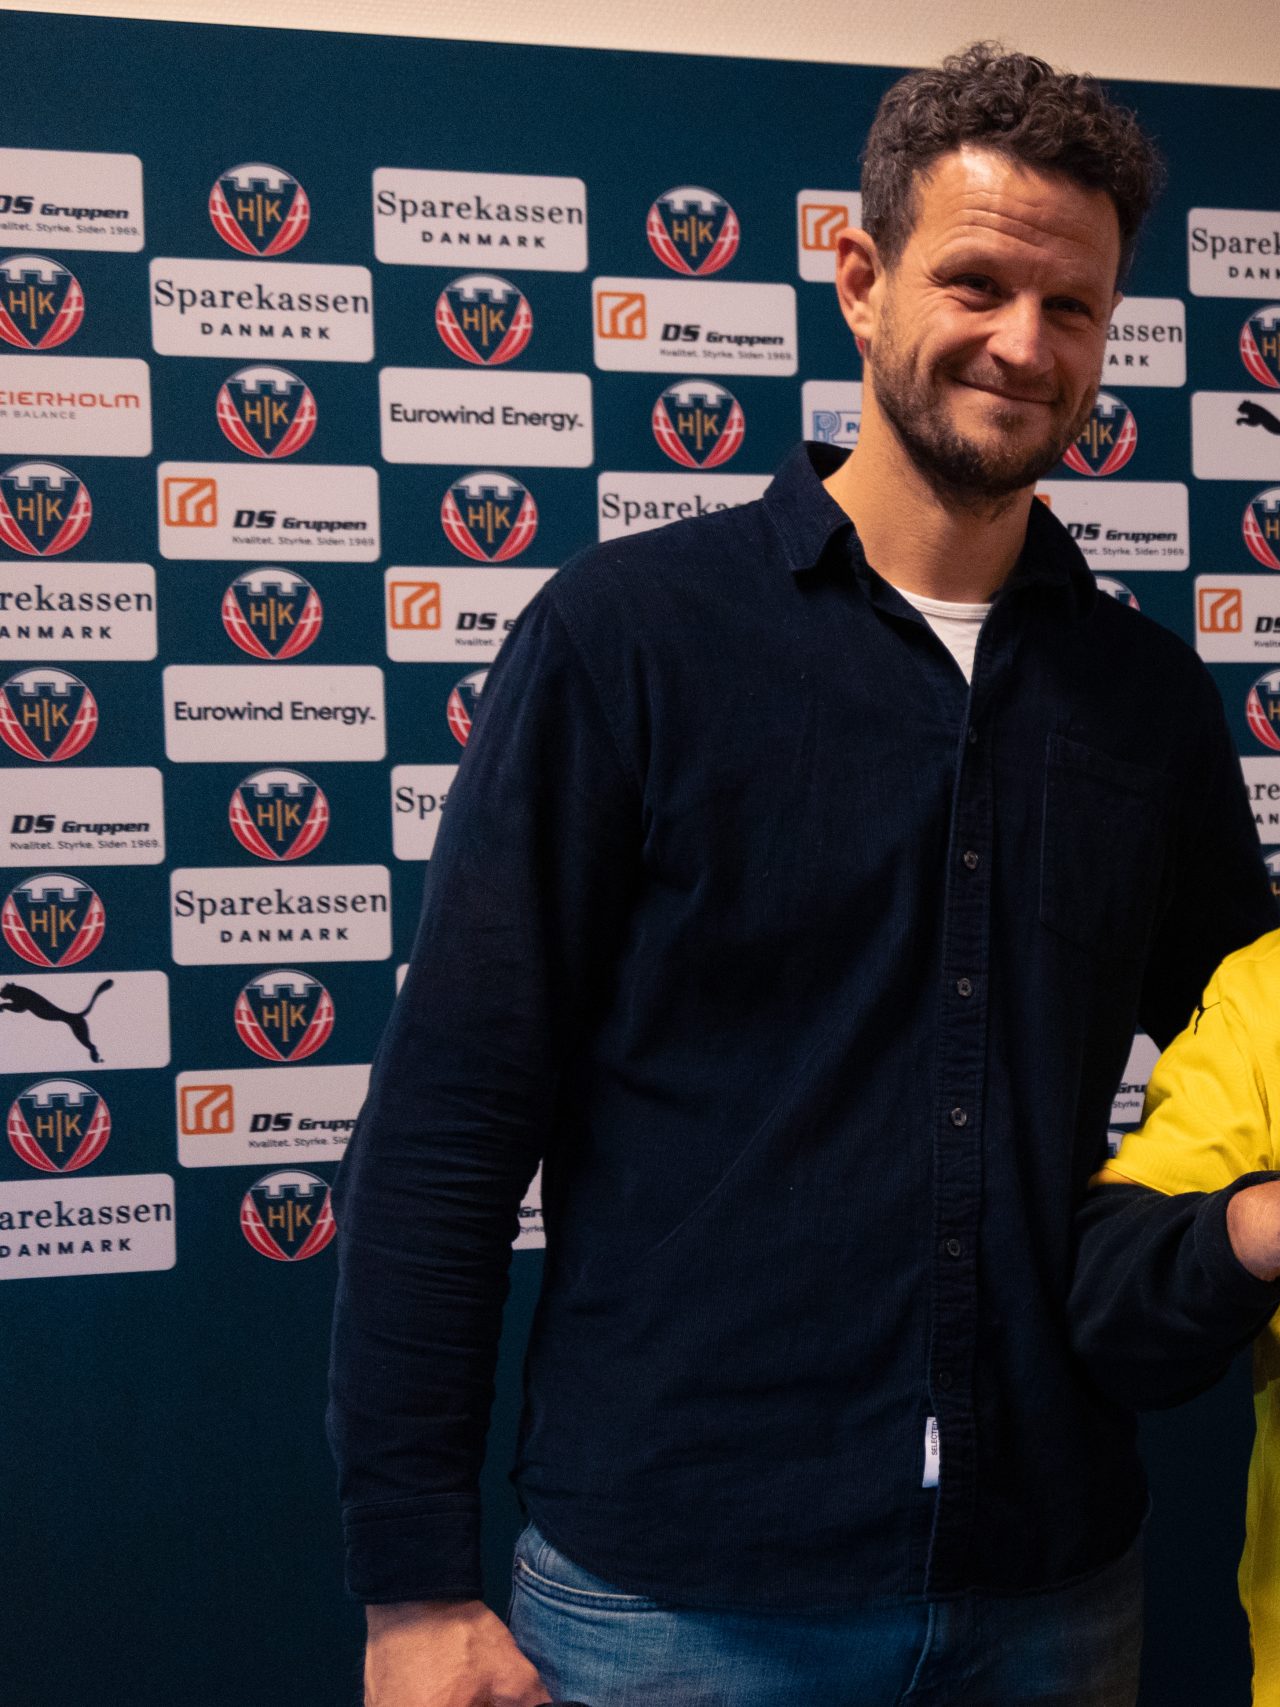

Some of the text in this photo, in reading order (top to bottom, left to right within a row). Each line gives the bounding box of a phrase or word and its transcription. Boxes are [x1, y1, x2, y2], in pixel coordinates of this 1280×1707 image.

[40, 204, 129, 220] Gruppen
[378, 191, 582, 224] Sparekassen
[77, 225, 106, 233] Siden
[422, 231, 544, 248] DANMARK
[155, 280, 368, 314] Sparekassen
[201, 323, 329, 339] DANMARK
[662, 324, 784, 346] DS Gruppen
[738, 351, 764, 359] Siden
[13, 410, 77, 420] BALANCE
[390, 403, 494, 424] Eurowind
[234, 510, 367, 532] DS Gruppen
[1106, 530, 1177, 543] Gruppen
[457, 613, 497, 630] DS
[174, 702, 283, 720] Eurowind
[11, 815, 149, 835] DS Gruppen
[58, 841, 93, 850] Styrke.
[98, 840, 127, 848] Siden
[175, 889, 387, 924] Sparekassen
[221, 928, 348, 943] DANMARK
[250, 1113, 292, 1132] DS
[294, 1138, 328, 1147] Styrke.
